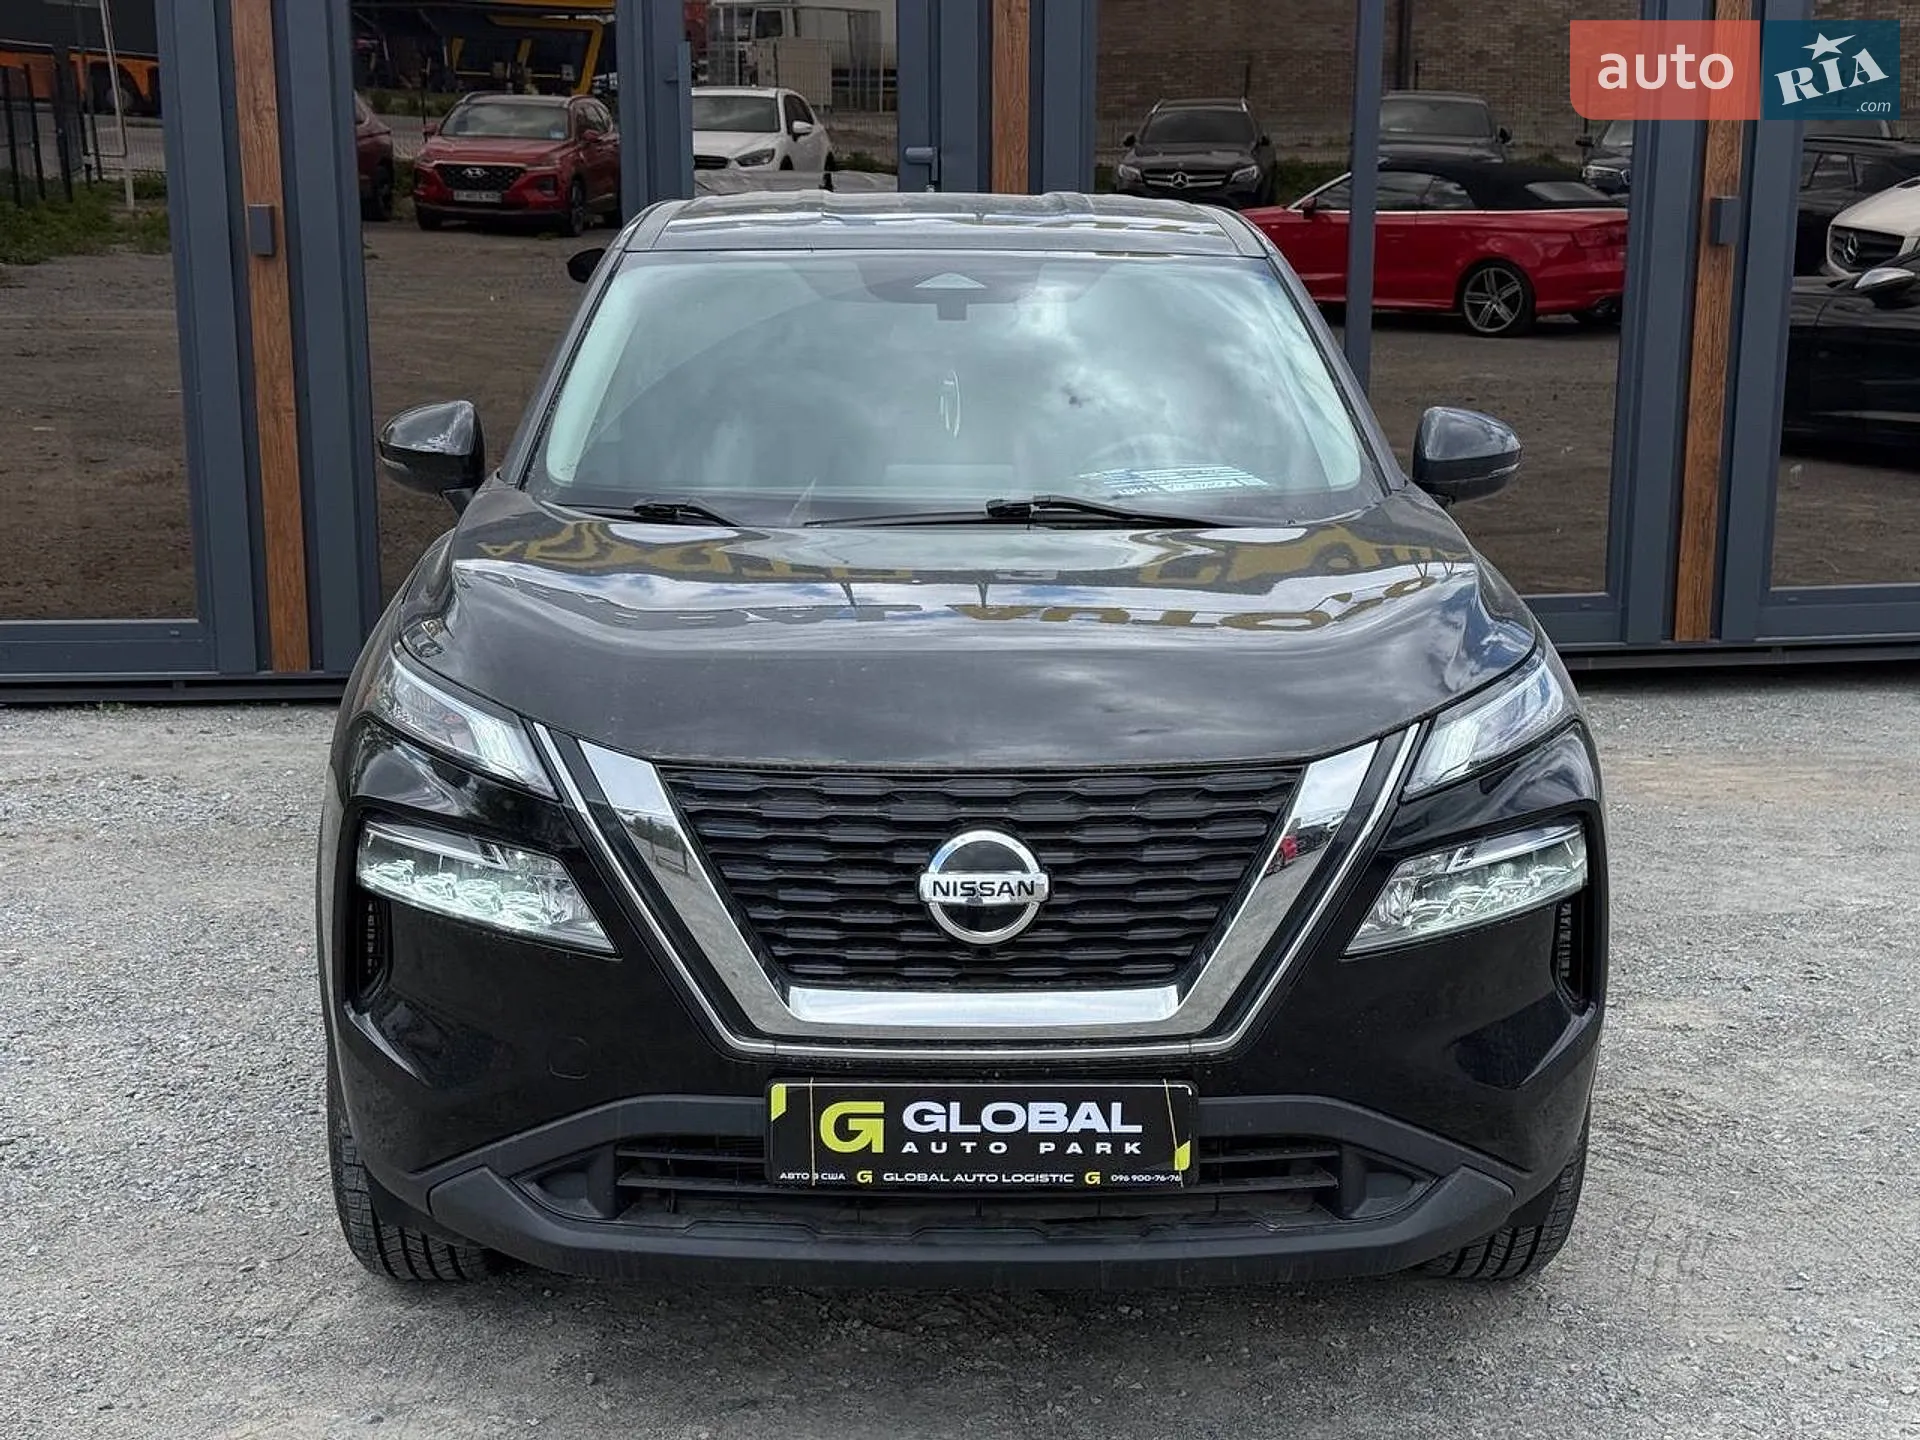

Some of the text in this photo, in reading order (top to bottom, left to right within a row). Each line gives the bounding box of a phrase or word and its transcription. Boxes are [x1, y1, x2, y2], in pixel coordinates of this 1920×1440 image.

[932, 880, 1035, 897] NISSAN
[902, 1100, 1143, 1134] GLOBAL
[901, 1141, 1142, 1155] AUTO PARK
[820, 1172, 846, 1181] США
[883, 1172, 1075, 1183] GLOBAL AUTO LOGISTIC
[1110, 1174, 1130, 1182] 096
